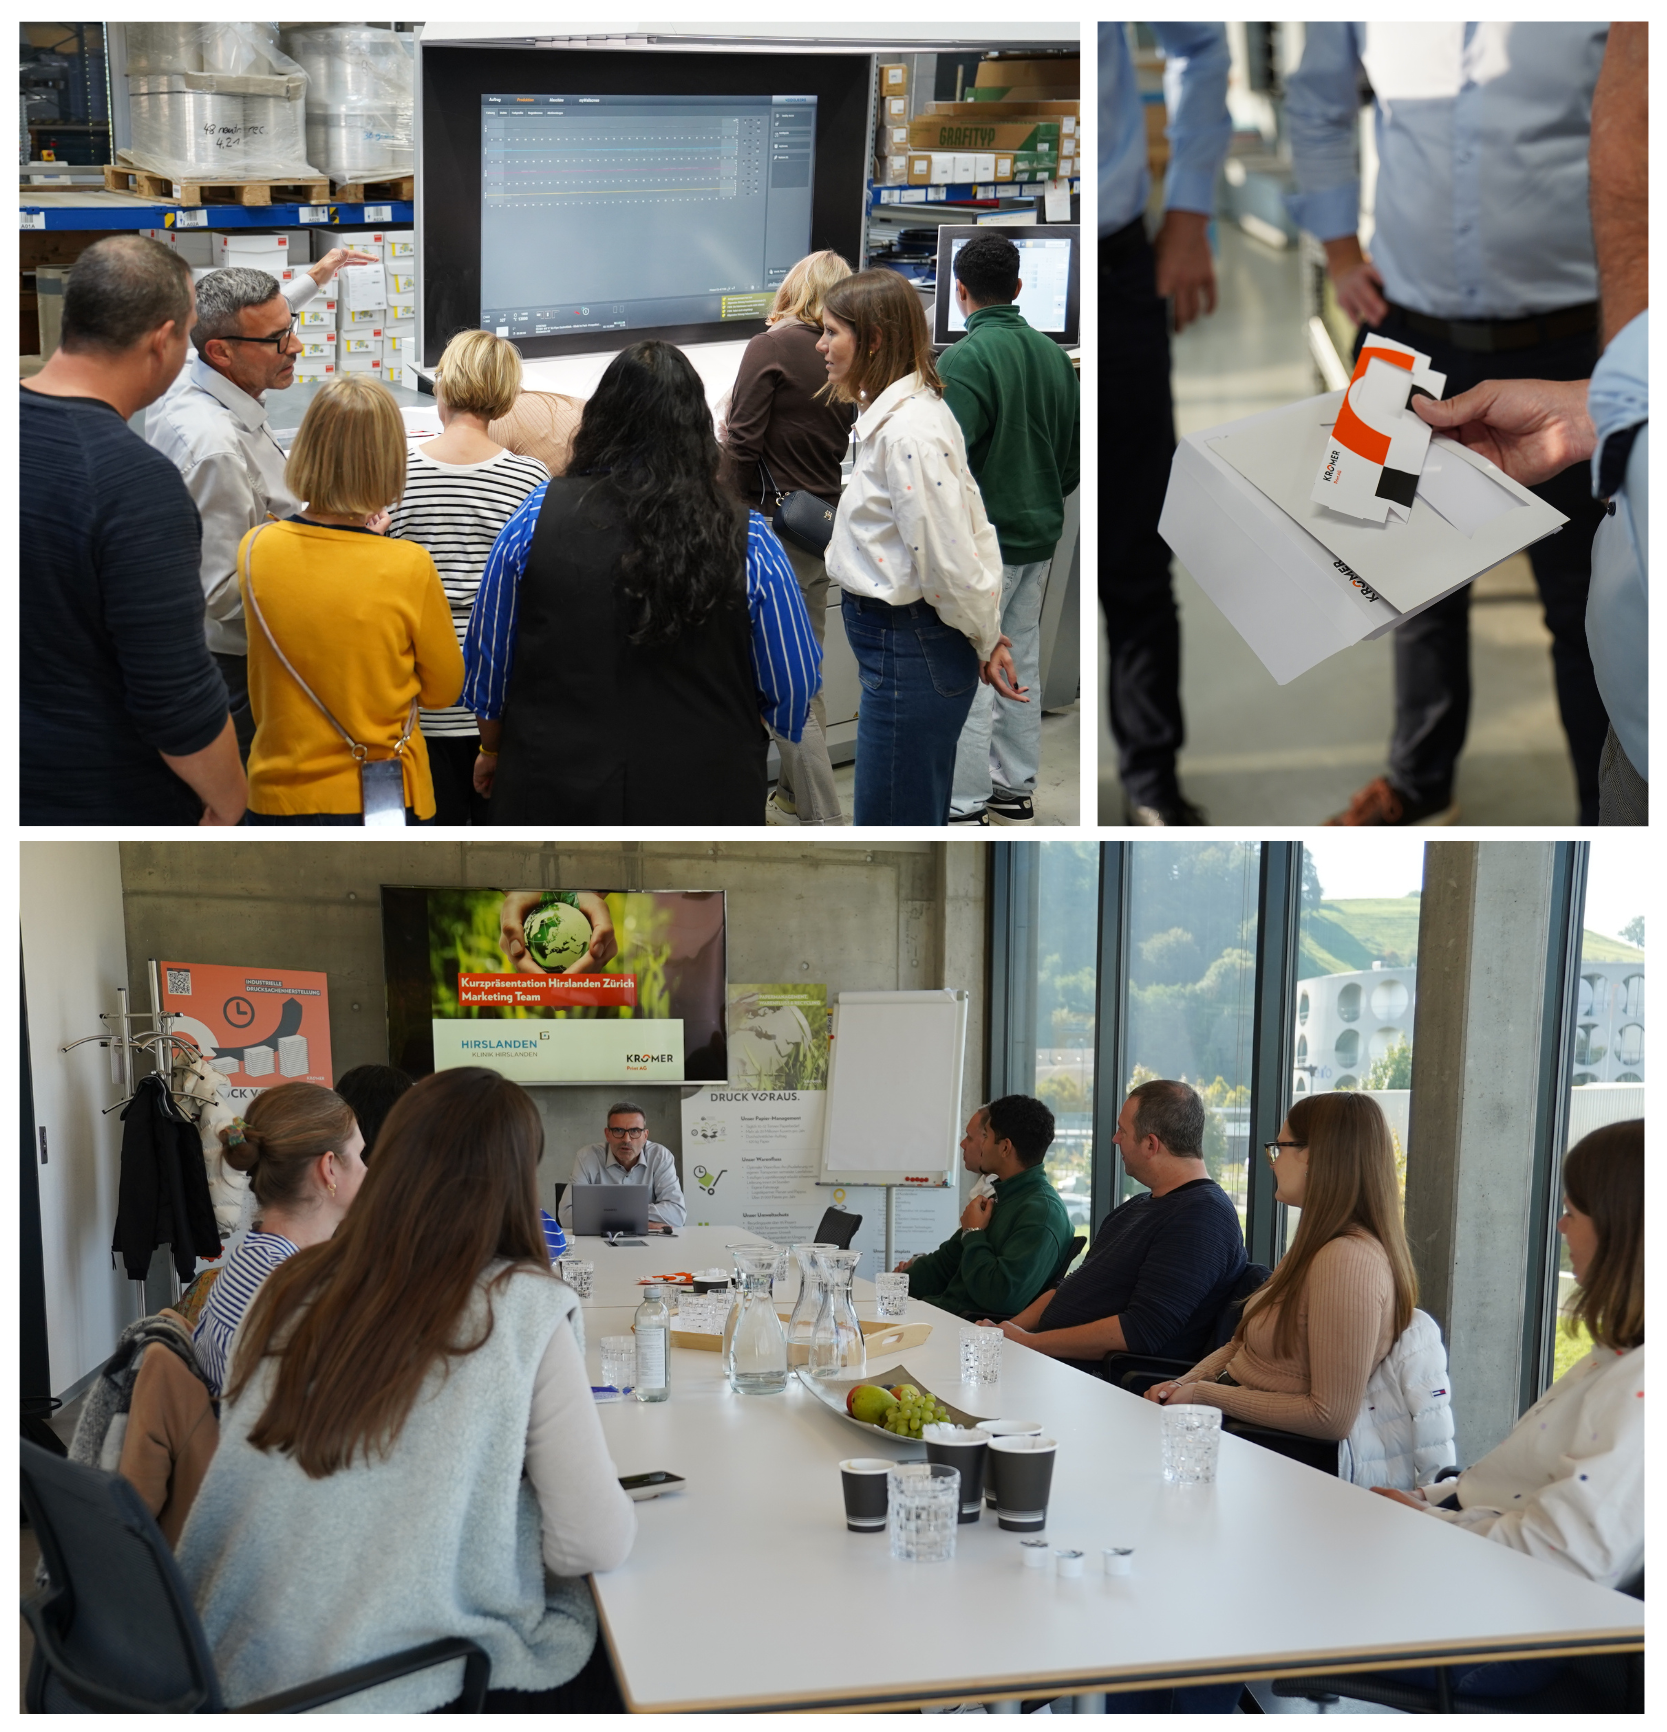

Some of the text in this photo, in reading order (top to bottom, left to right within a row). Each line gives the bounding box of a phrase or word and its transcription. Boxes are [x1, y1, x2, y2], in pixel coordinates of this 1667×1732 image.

[939, 126, 996, 147] GRAFITYP
[1323, 450, 1340, 482] KROMER
[1333, 560, 1379, 602] KROMER
[245, 979, 282, 987] INDUSTRIELLE
[461, 977, 635, 990] Kurzpräsentation Hirslanden Zürich
[246, 986, 321, 996] DRUCKSACHENHERSTELLUNG
[461, 991, 541, 1003] Marketing Team
[461, 1040, 538, 1049] HIRSLANDEN
[626, 1054, 674, 1063] KROMER
[710, 1092, 800, 1102] DRUCK VORAUS.
